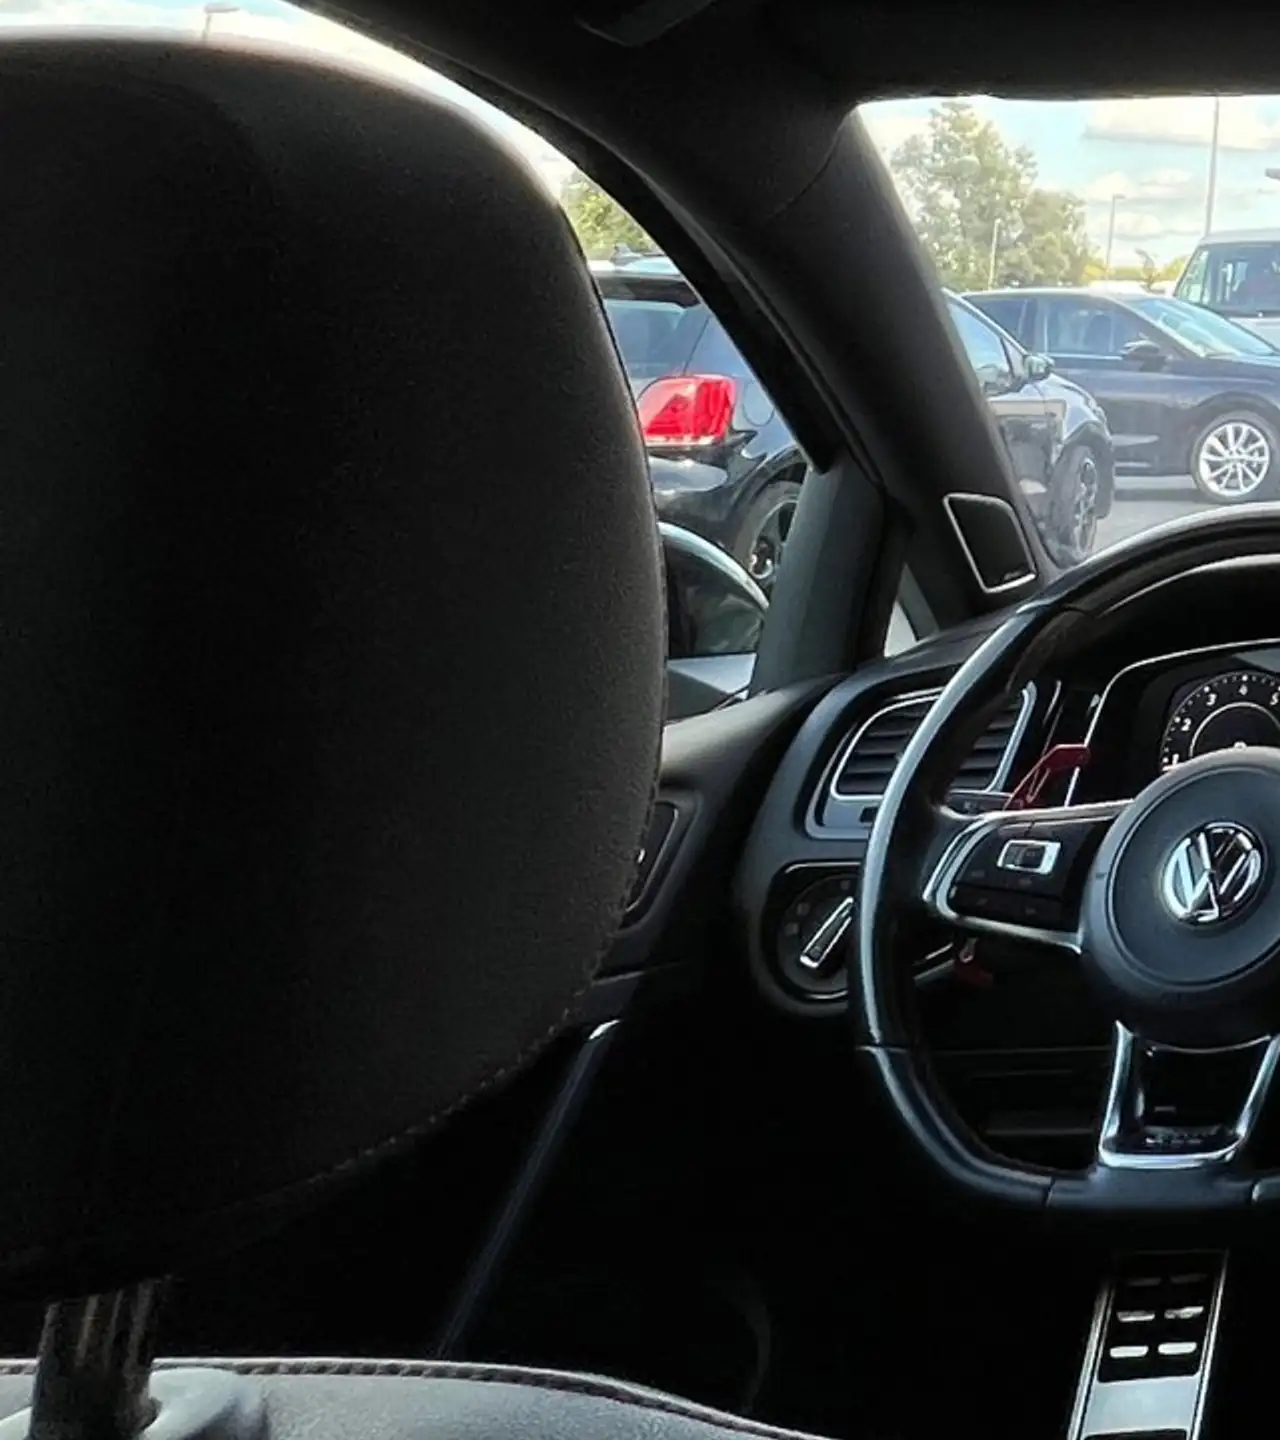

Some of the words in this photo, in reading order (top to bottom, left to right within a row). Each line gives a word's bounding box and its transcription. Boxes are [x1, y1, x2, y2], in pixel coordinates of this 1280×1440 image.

[1206, 692, 1218, 706] 3
[1270, 692, 1280, 706] 5
[1181, 718, 1192, 732] 2
